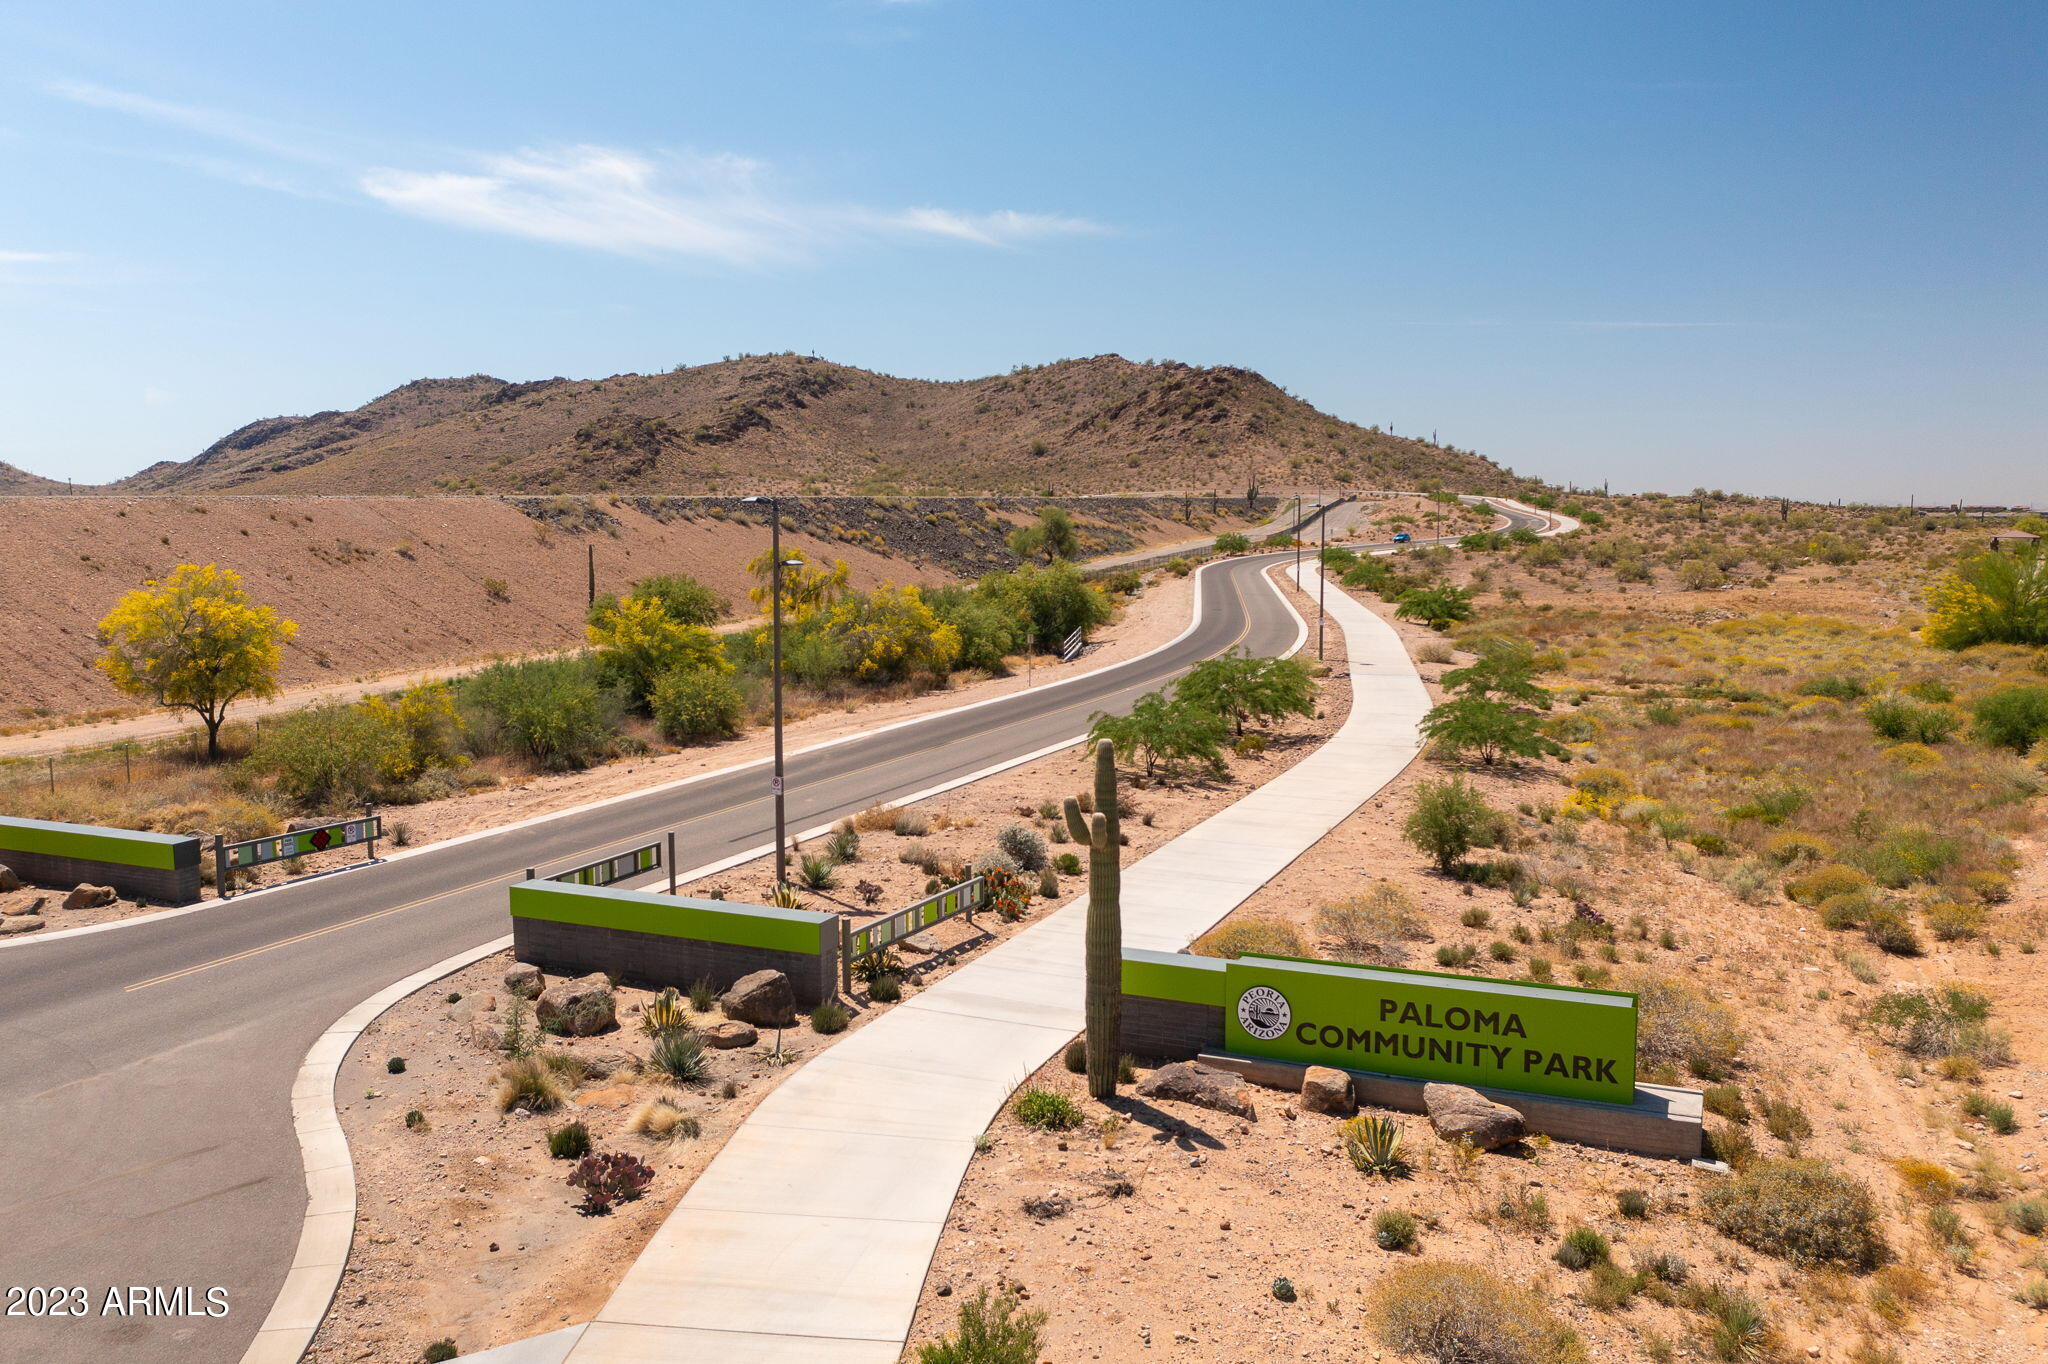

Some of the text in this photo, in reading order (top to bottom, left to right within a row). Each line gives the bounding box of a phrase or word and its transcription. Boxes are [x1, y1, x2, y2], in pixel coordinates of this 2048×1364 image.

[1242, 988, 1285, 1009] PEORIA
[1241, 1017, 1287, 1038] ARIZONA
[1380, 998, 1527, 1039] PALOMA
[1296, 1022, 1618, 1084] COMMUNITY PARK
